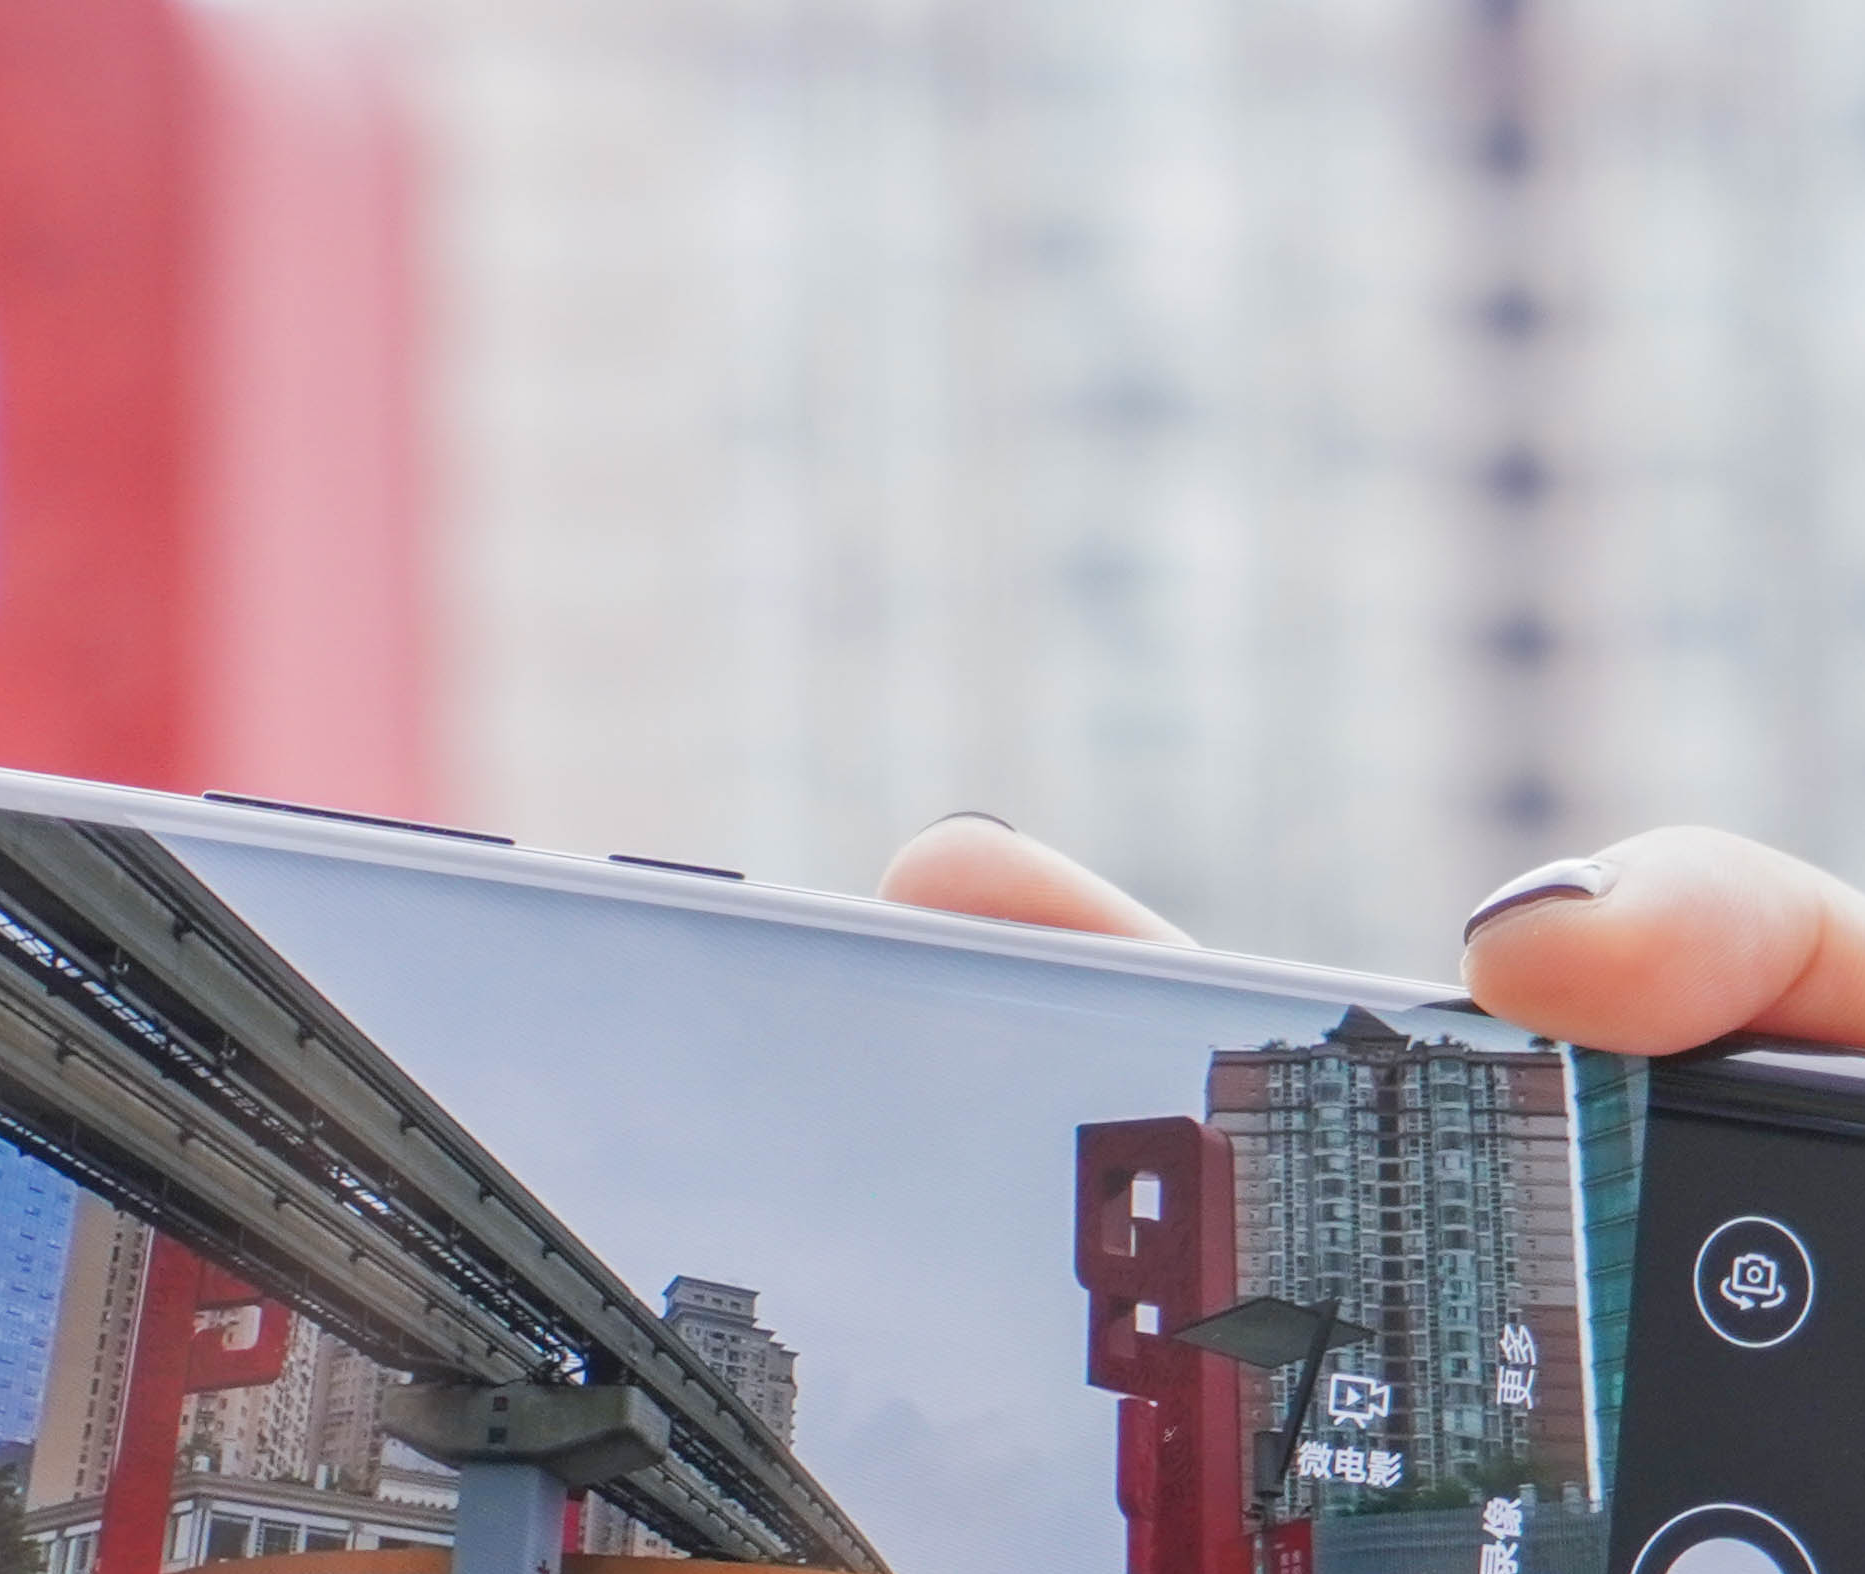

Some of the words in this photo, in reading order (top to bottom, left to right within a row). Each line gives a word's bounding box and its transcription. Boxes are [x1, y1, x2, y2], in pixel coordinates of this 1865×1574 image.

[1499, 1324, 1536, 1408] 更多
[1297, 1443, 1401, 1488] 微电影
